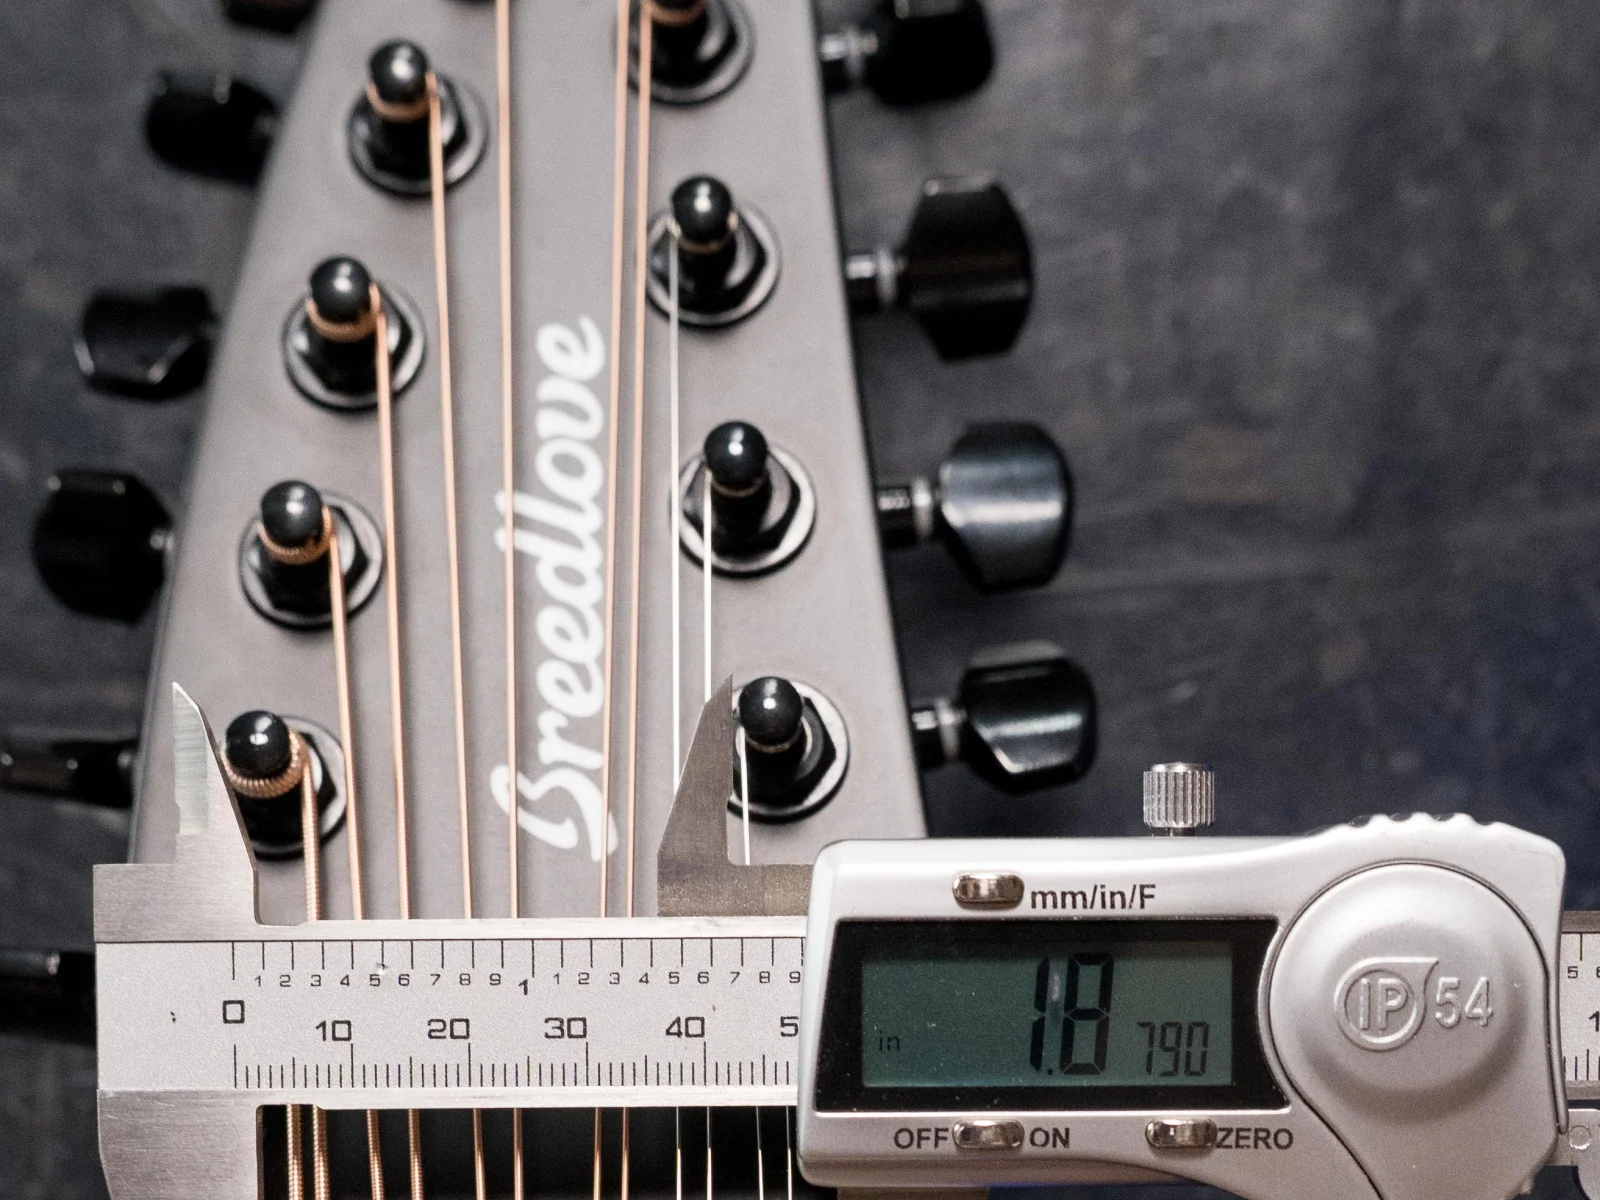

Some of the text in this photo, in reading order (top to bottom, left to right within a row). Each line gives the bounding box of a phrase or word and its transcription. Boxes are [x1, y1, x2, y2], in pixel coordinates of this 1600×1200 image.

[490, 314, 619, 862] Breedlove
[1030, 884, 1157, 910] mm/in/F
[254, 970, 802, 996] 1 2 3 4 5 6 7 8 9 1 1 2 3 4 5 6 7 8 9
[1567, 965, 1579, 979] 5
[222, 999, 246, 1025] 0
[1358, 975, 1494, 1031] IP 54
[314, 1015, 799, 1042] 10 20 30 40 5
[877, 1029, 901, 1053] in
[893, 1126, 1071, 1151] OFF ON
[1215, 1126, 1295, 1151] ZERO
